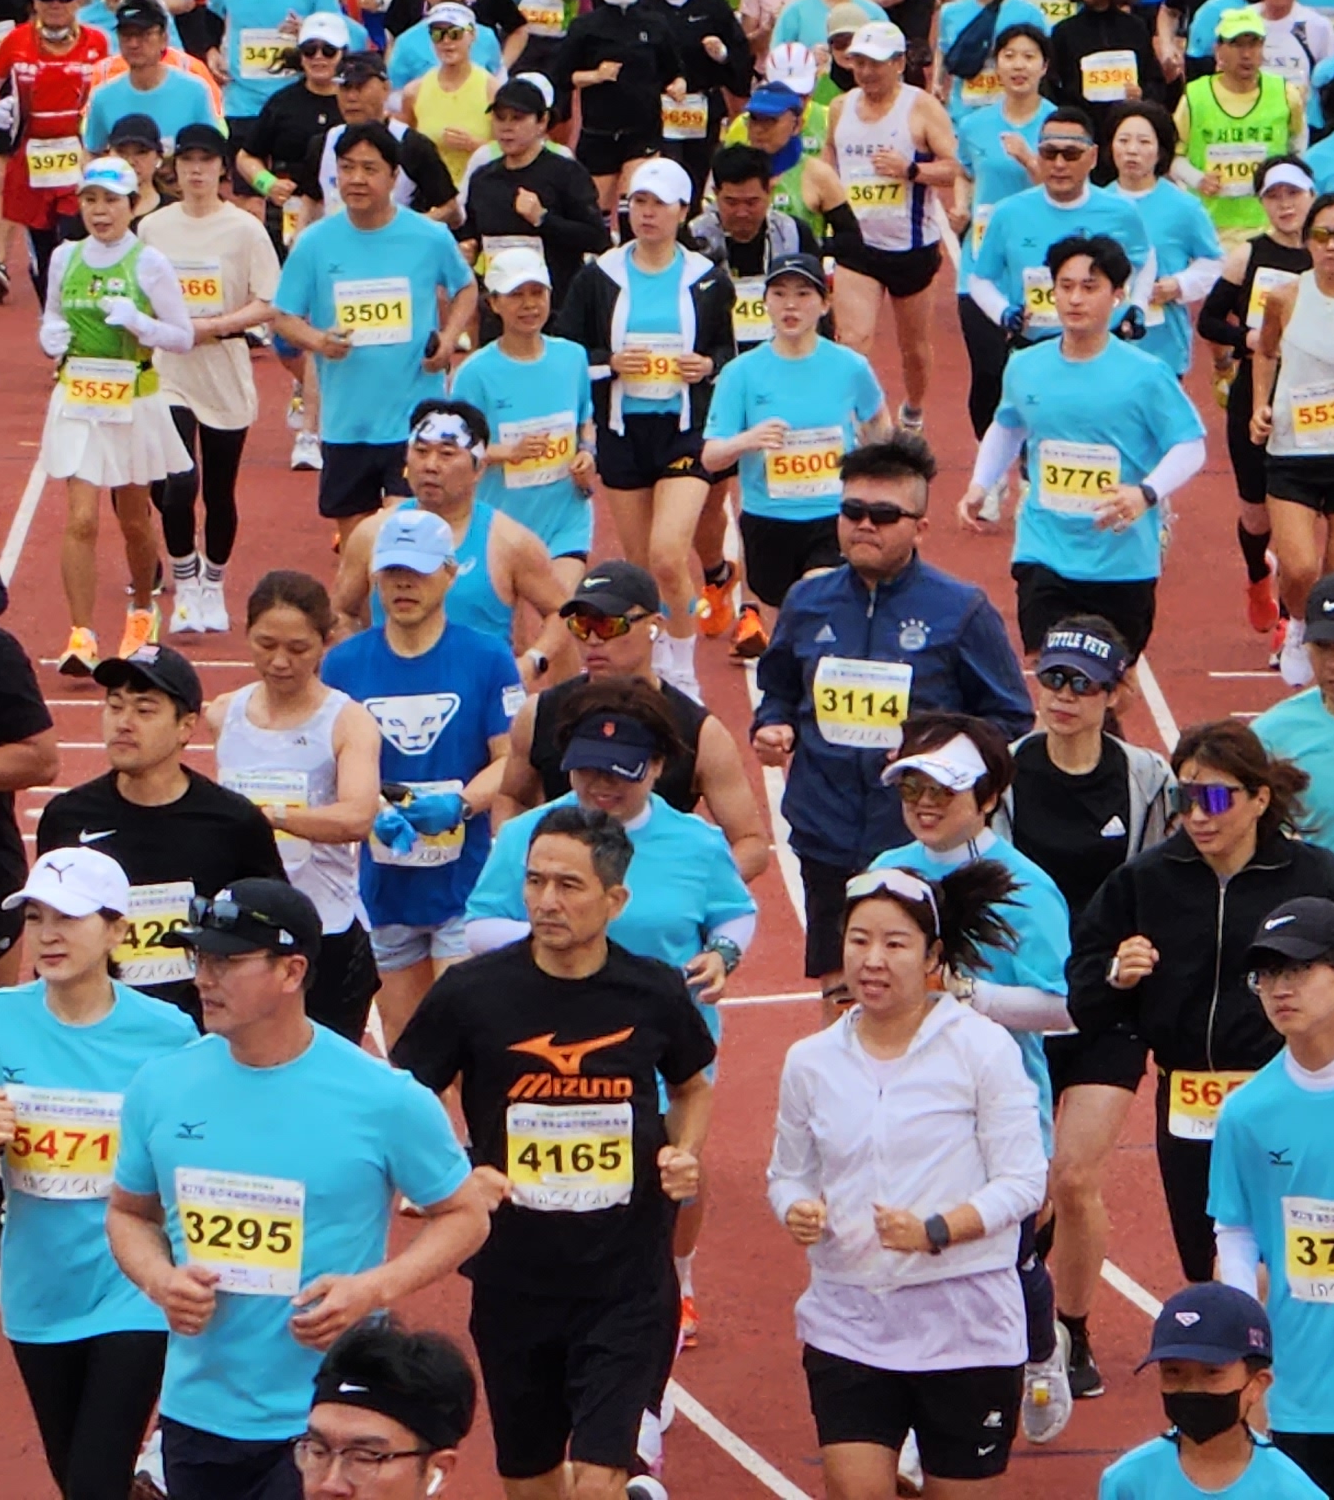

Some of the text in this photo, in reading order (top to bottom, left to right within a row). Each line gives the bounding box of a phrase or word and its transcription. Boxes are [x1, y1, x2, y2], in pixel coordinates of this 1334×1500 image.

[32, 149, 80, 170] 3979
[849, 182, 900, 202] 3677
[342, 302, 404, 326] 3501
[70, 378, 131, 403] 5557
[772, 451, 839, 476] 5600
[1045, 465, 1112, 491] 3776
[821, 687, 900, 718] 3114
[506, 1073, 633, 1100] MIZUNO
[13, 1131, 111, 1161] 5471
[517, 1140, 622, 1174] 4165
[186, 1211, 294, 1255] 3295
